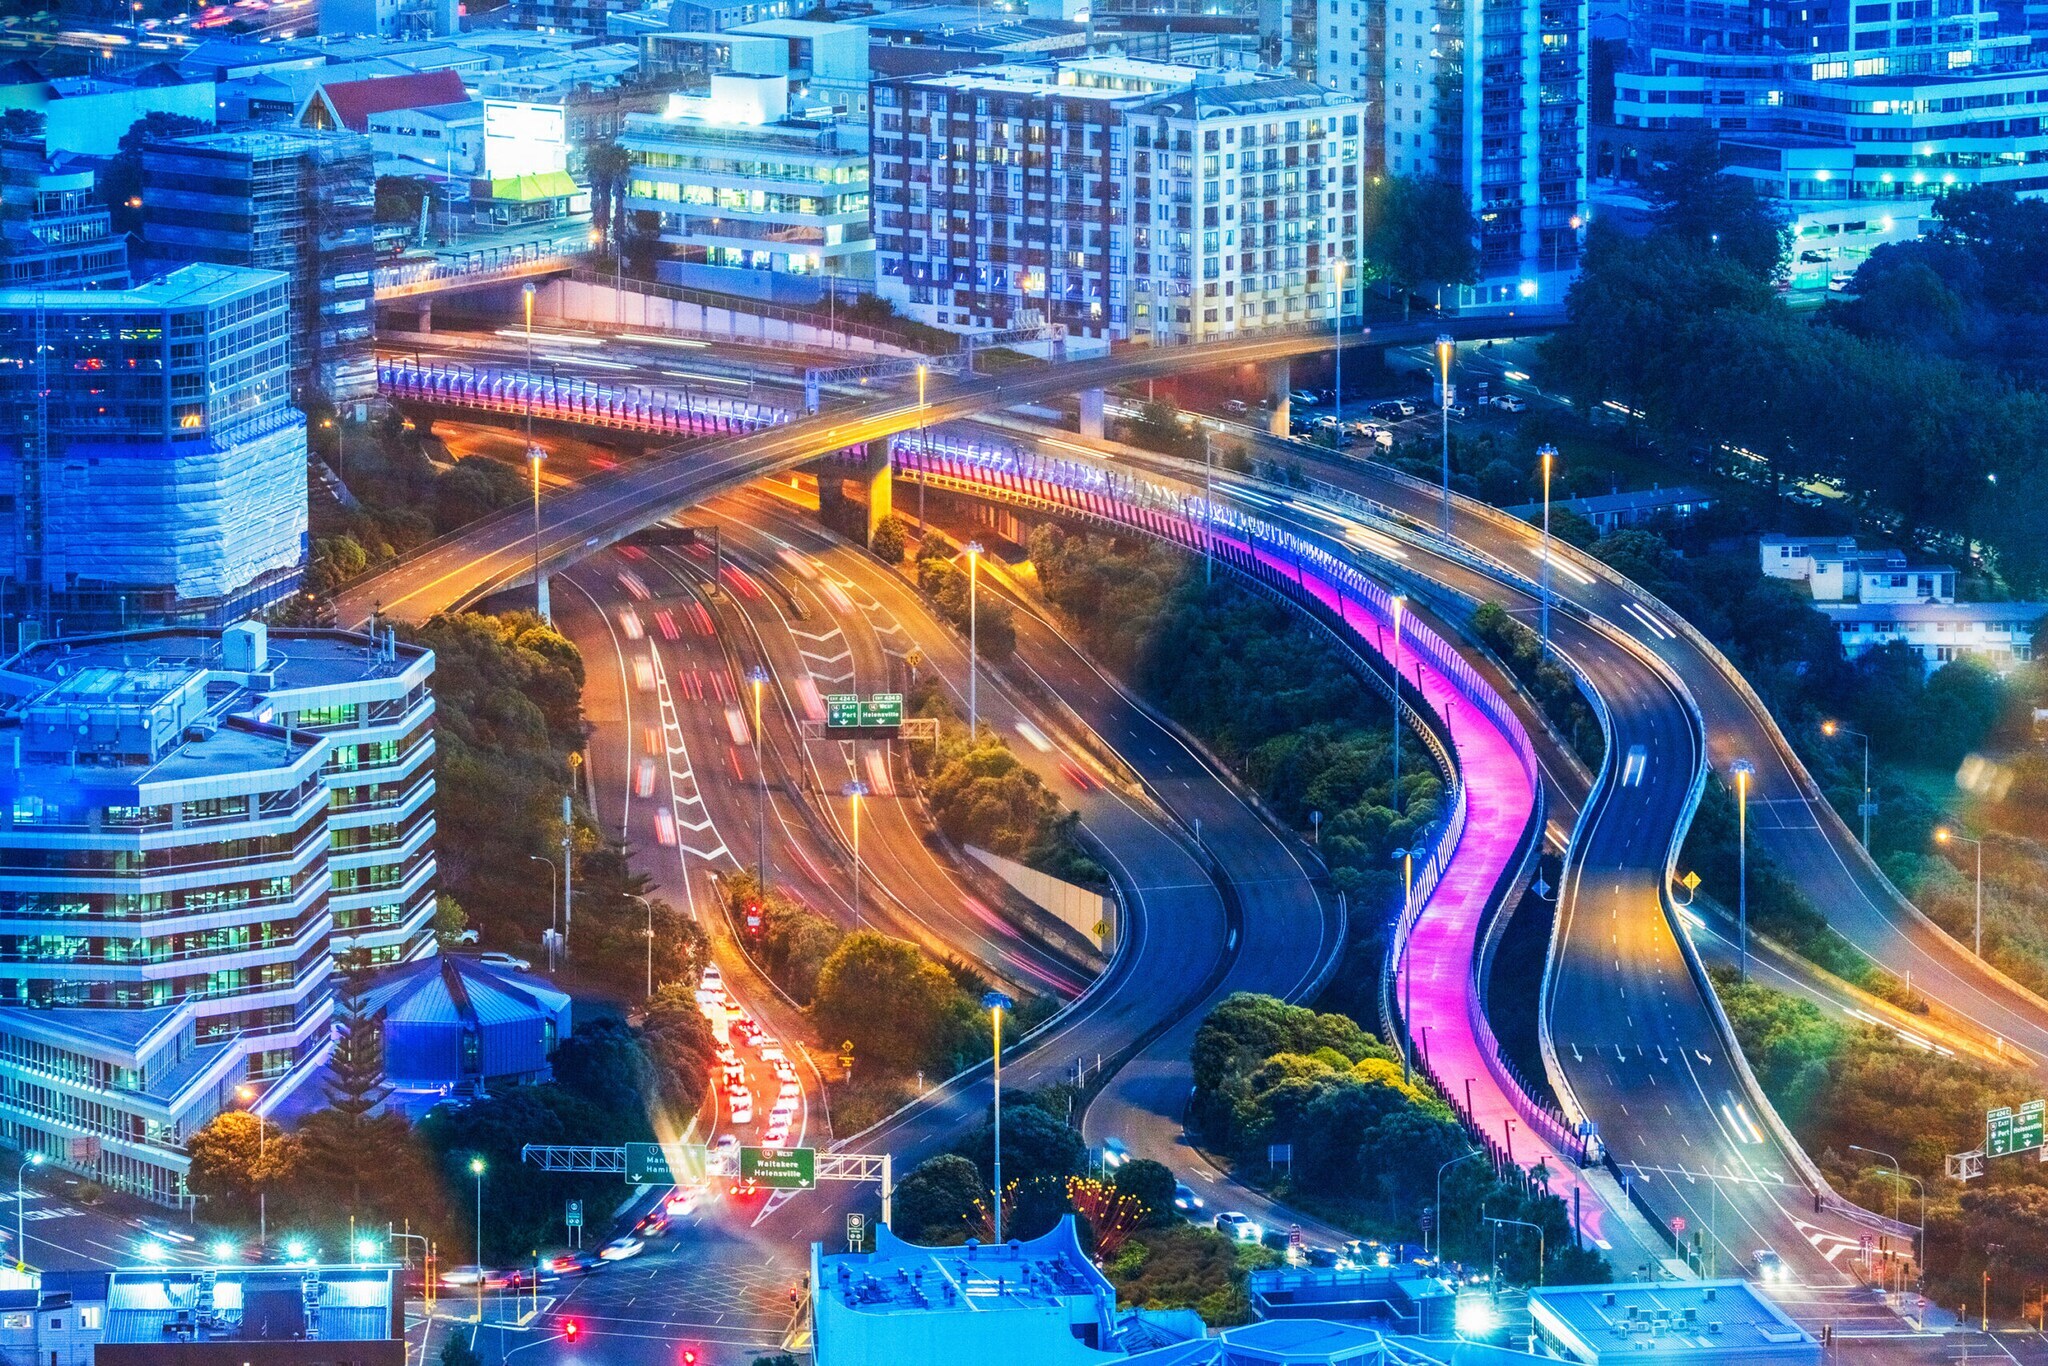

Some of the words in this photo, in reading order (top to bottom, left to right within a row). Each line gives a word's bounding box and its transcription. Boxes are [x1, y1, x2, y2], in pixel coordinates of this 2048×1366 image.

[646, 1156, 685, 1164] Manuk
[757, 1160, 799, 1168] Waitakere
[754, 1169, 801, 1177] Helensville
